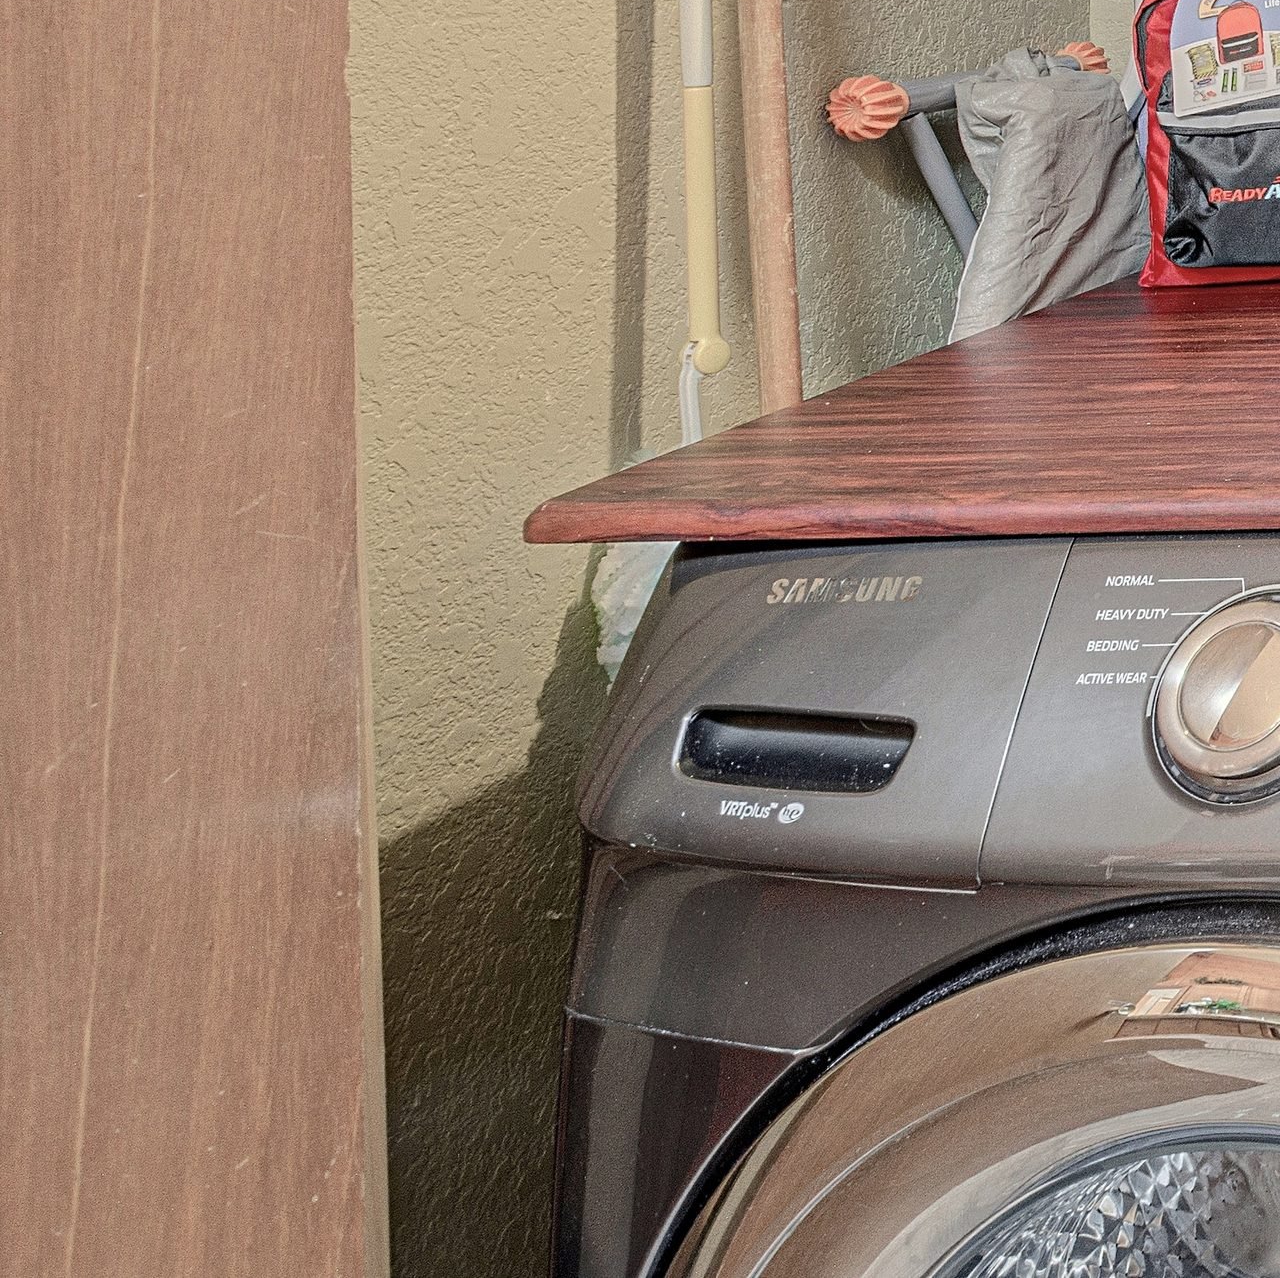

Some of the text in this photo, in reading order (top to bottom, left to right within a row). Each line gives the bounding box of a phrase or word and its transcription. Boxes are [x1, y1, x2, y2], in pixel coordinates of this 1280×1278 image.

[1105, 575, 1155, 587] NORMAL
[766, 575, 924, 604] SAMSUNG
[1095, 608, 1169, 621] HEAVY DUTY
[1086, 640, 1139, 651] BEDDING
[1076, 672, 1147, 684] ACTIVE WEAR
